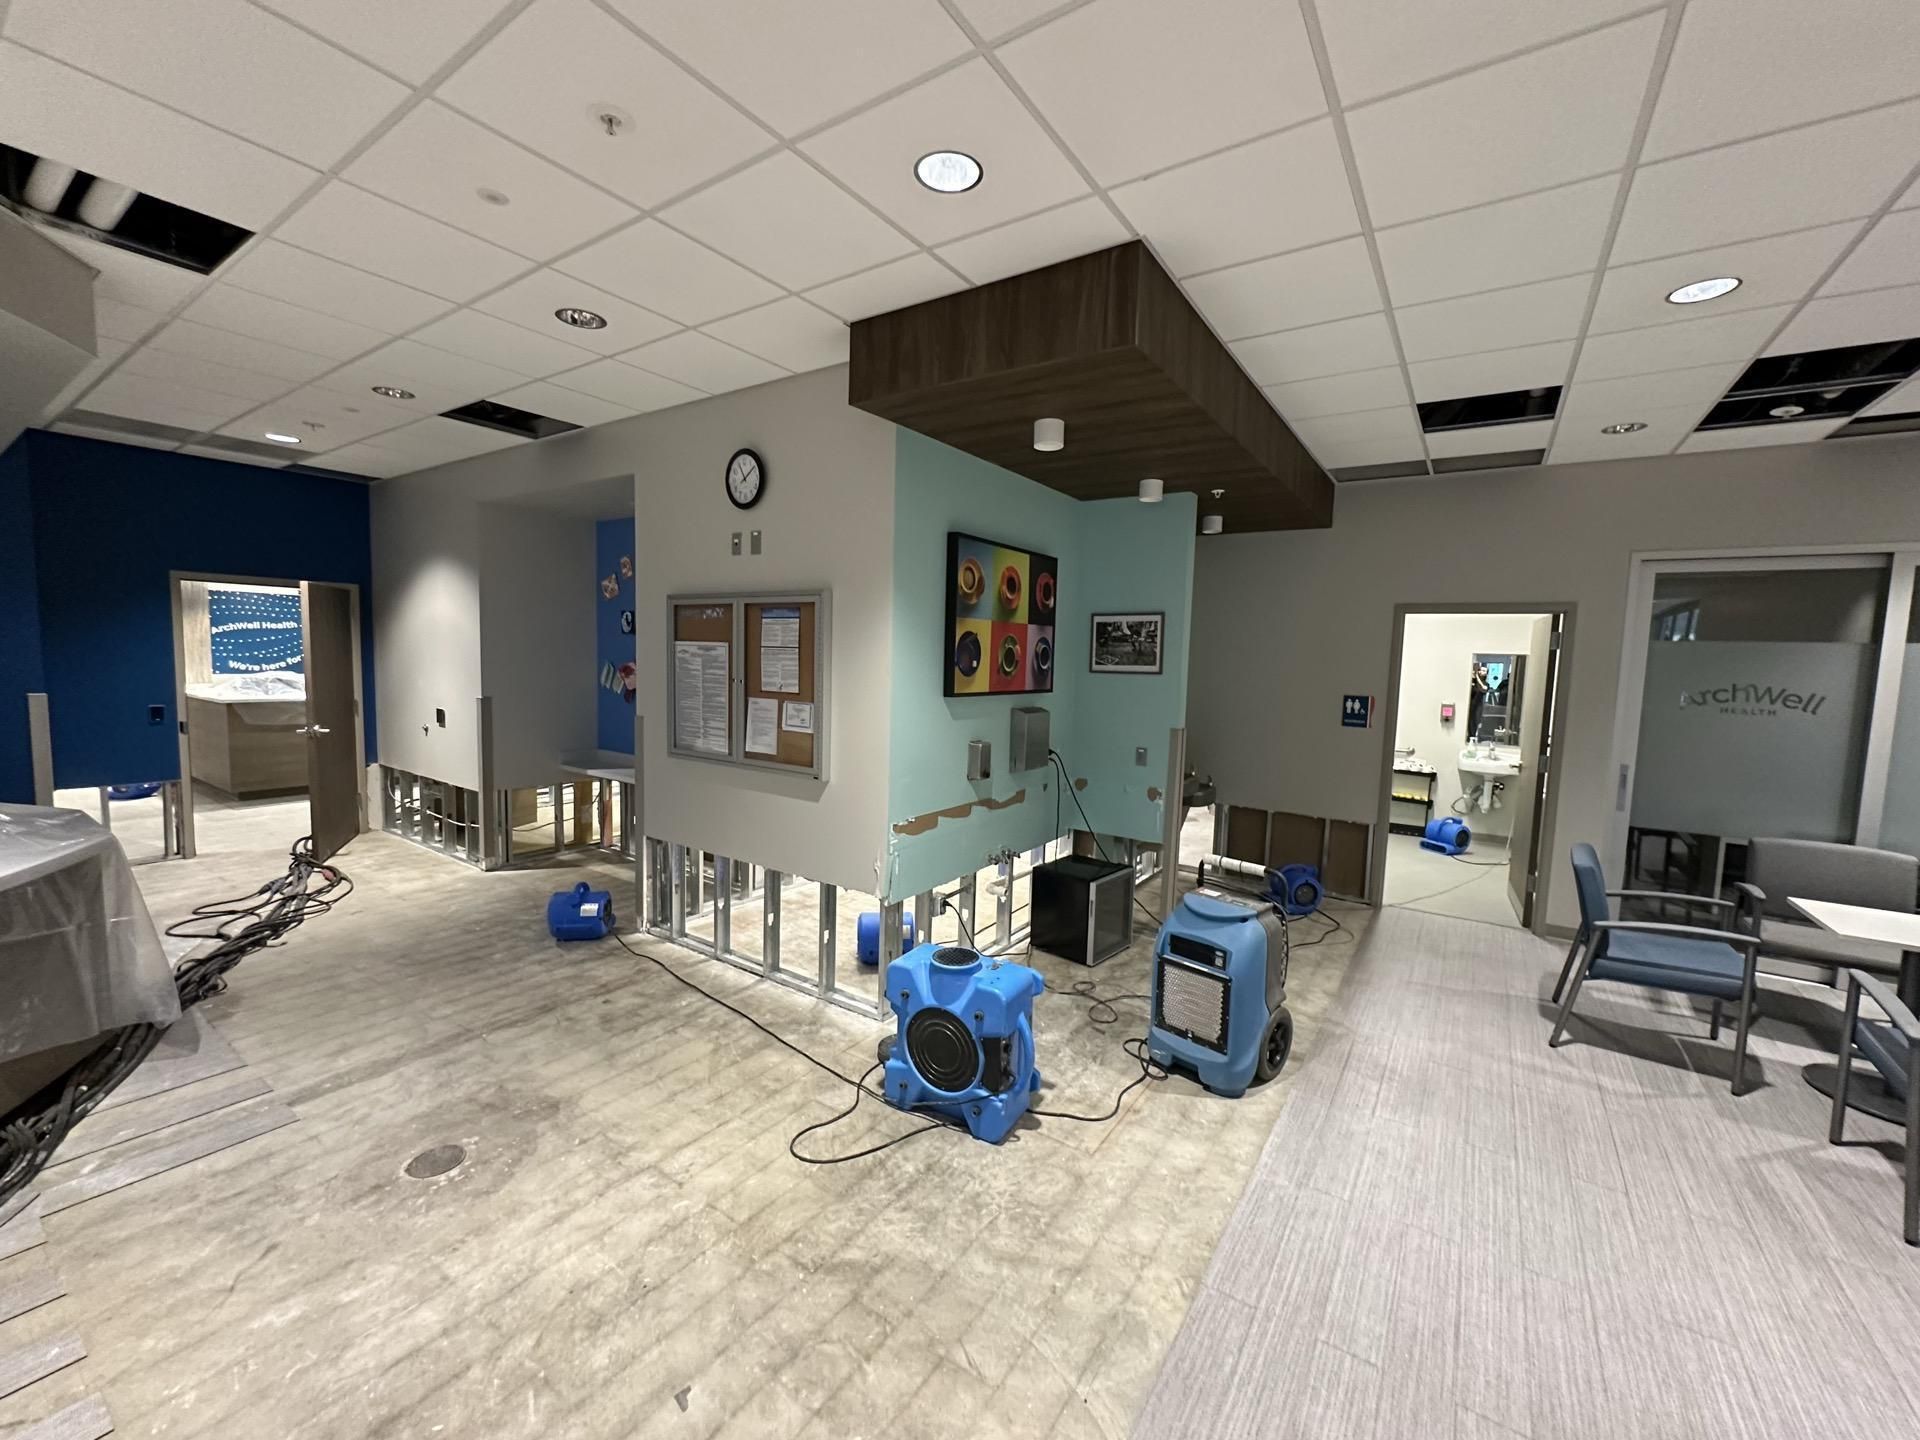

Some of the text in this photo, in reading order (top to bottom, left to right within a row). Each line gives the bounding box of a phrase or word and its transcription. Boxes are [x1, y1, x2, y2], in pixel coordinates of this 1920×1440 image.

[211, 621, 298, 634] ArchWell Health
[228, 656, 302, 671] We're here for
[1719, 706, 1777, 716] HEALTH
